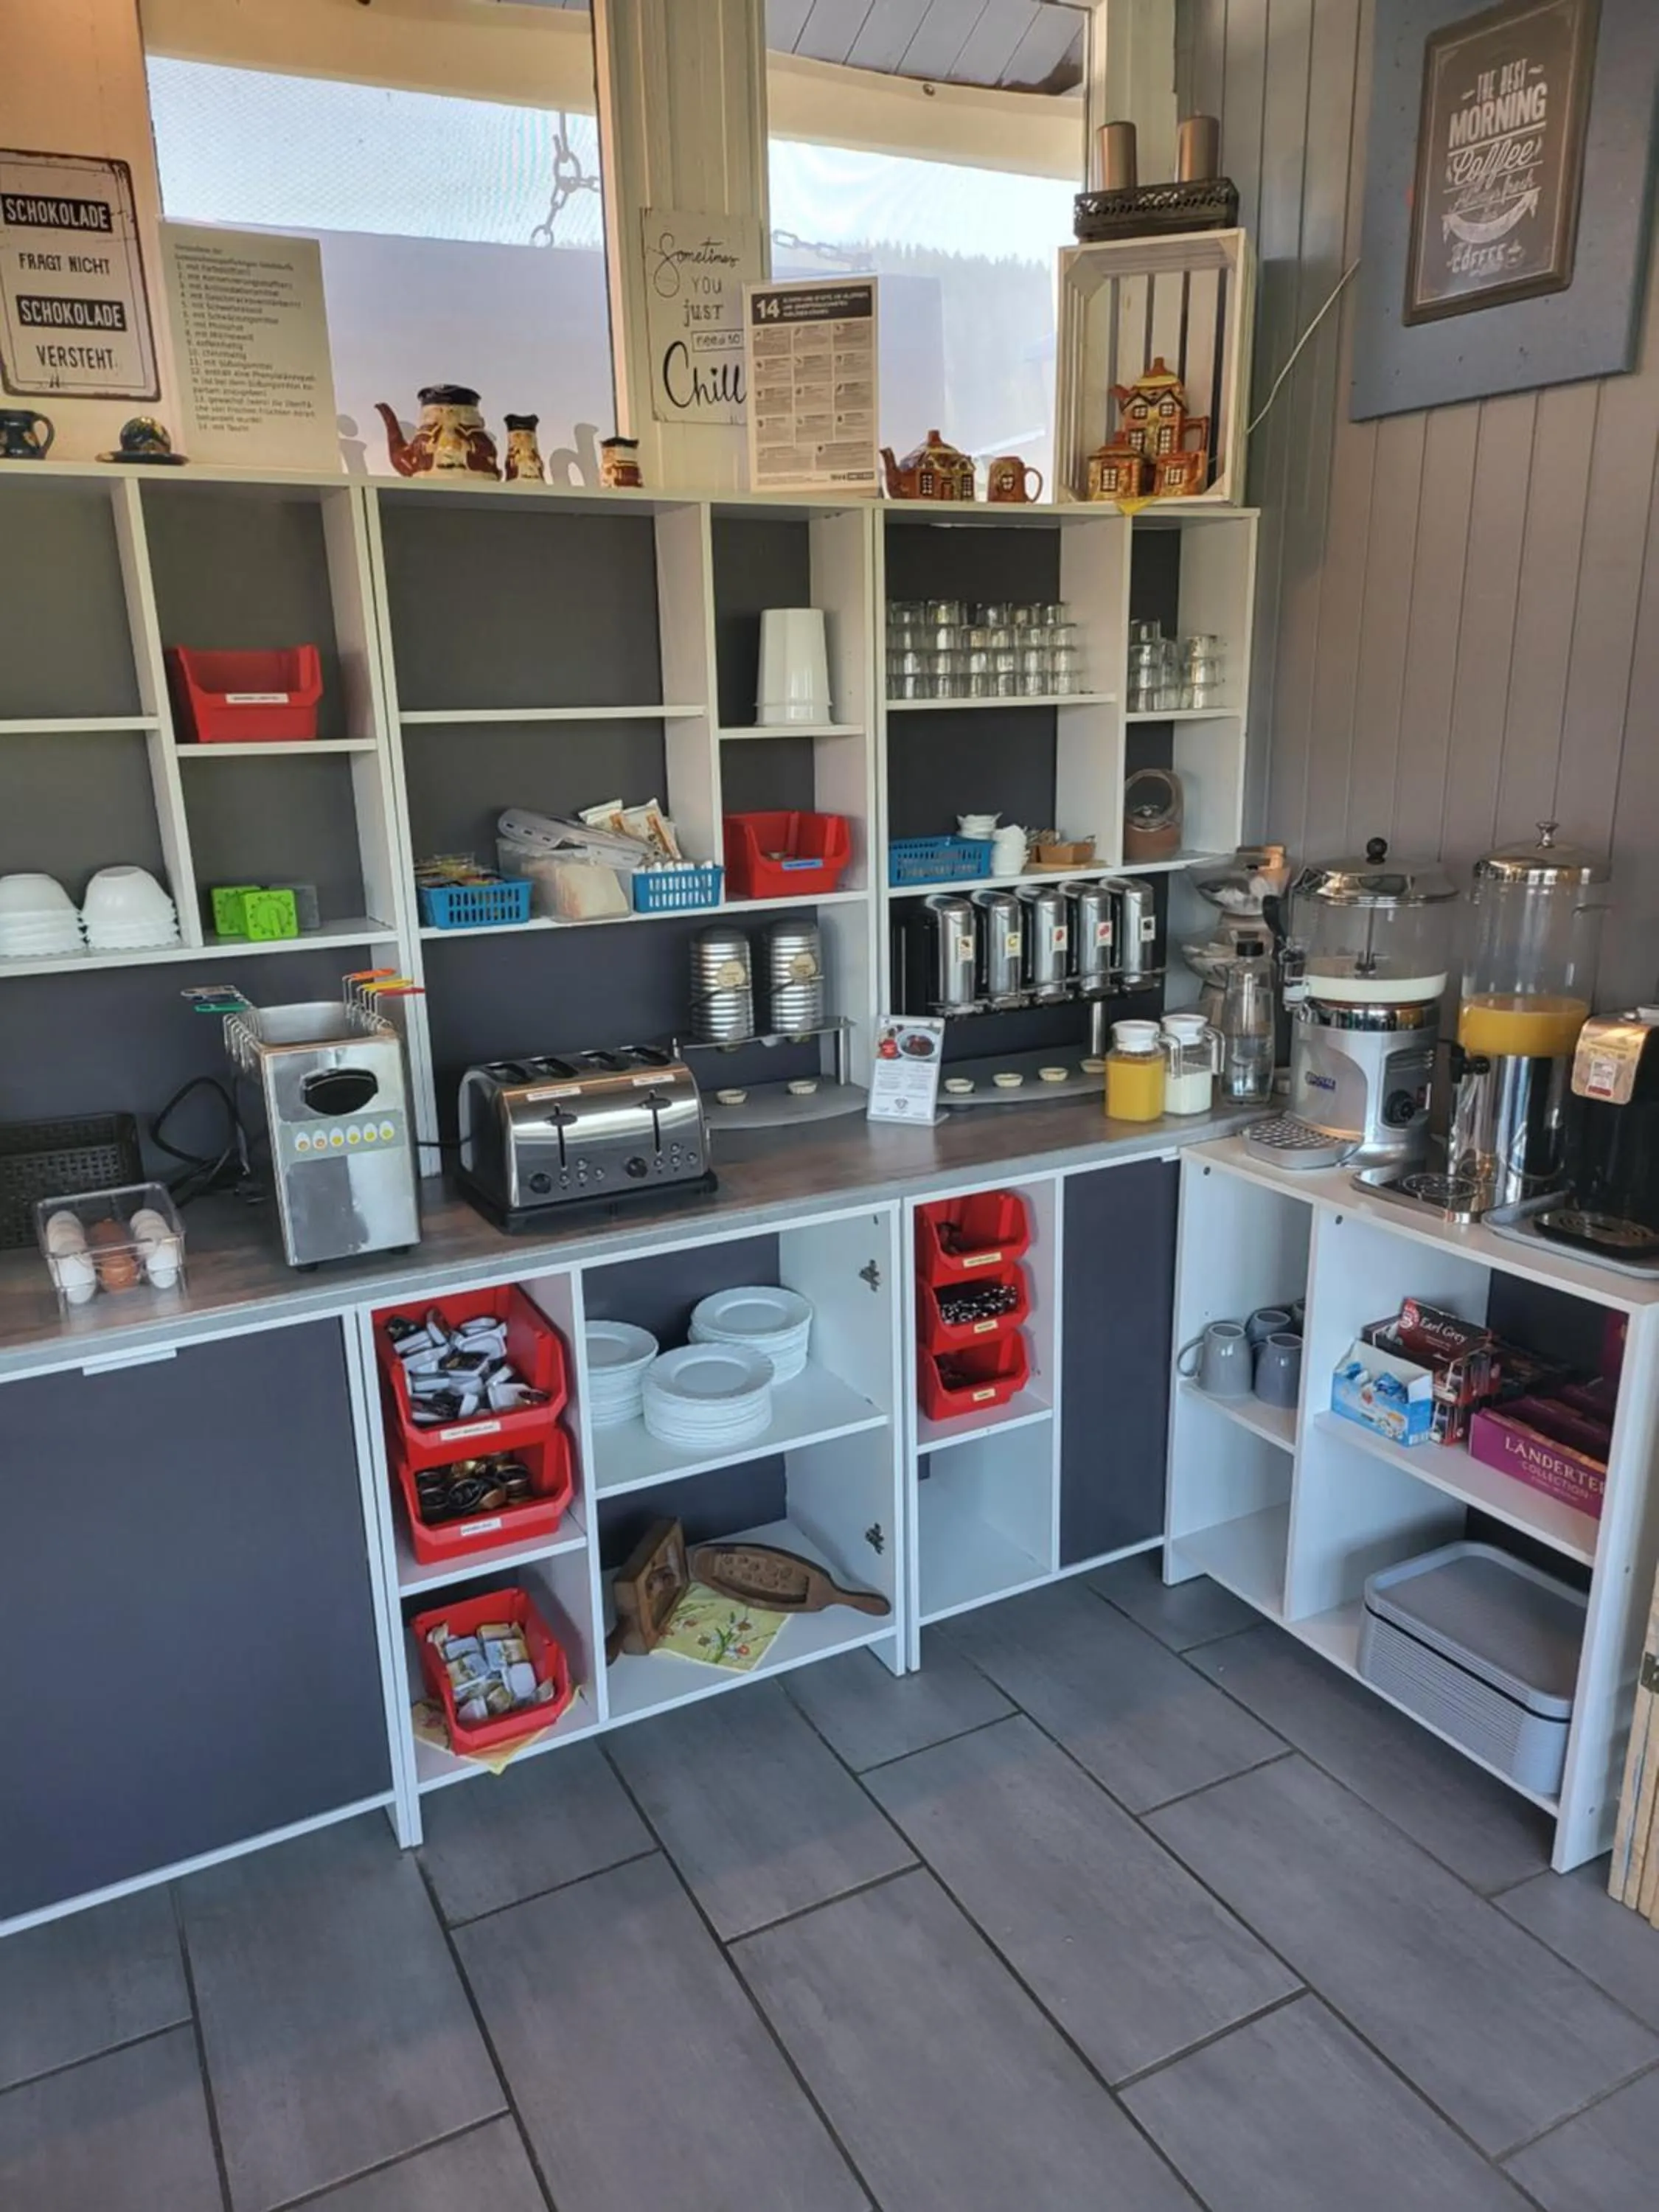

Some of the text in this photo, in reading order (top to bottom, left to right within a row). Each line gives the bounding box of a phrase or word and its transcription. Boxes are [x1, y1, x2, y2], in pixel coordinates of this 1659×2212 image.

[1500, 58, 1528, 98] BEST
[1448, 82, 1548, 148] MORNING
[1453, 138, 1536, 192] Coffee
[5, 198, 110, 230] SCHOKOLADE
[18, 252, 111, 275] FRAGT NICHT
[691, 276, 723, 295] YOU
[21, 300, 123, 327] SCHOKOLADE
[684, 299, 724, 327] just
[756, 298, 780, 319] 14
[36, 345, 114, 369] VERSTEHT
[663, 340, 747, 408] Chill
[1419, 1317, 1444, 1334] Earl
[1442, 1326, 1469, 1345] Grey
[1521, 1461, 1590, 1499] COLLECTION
